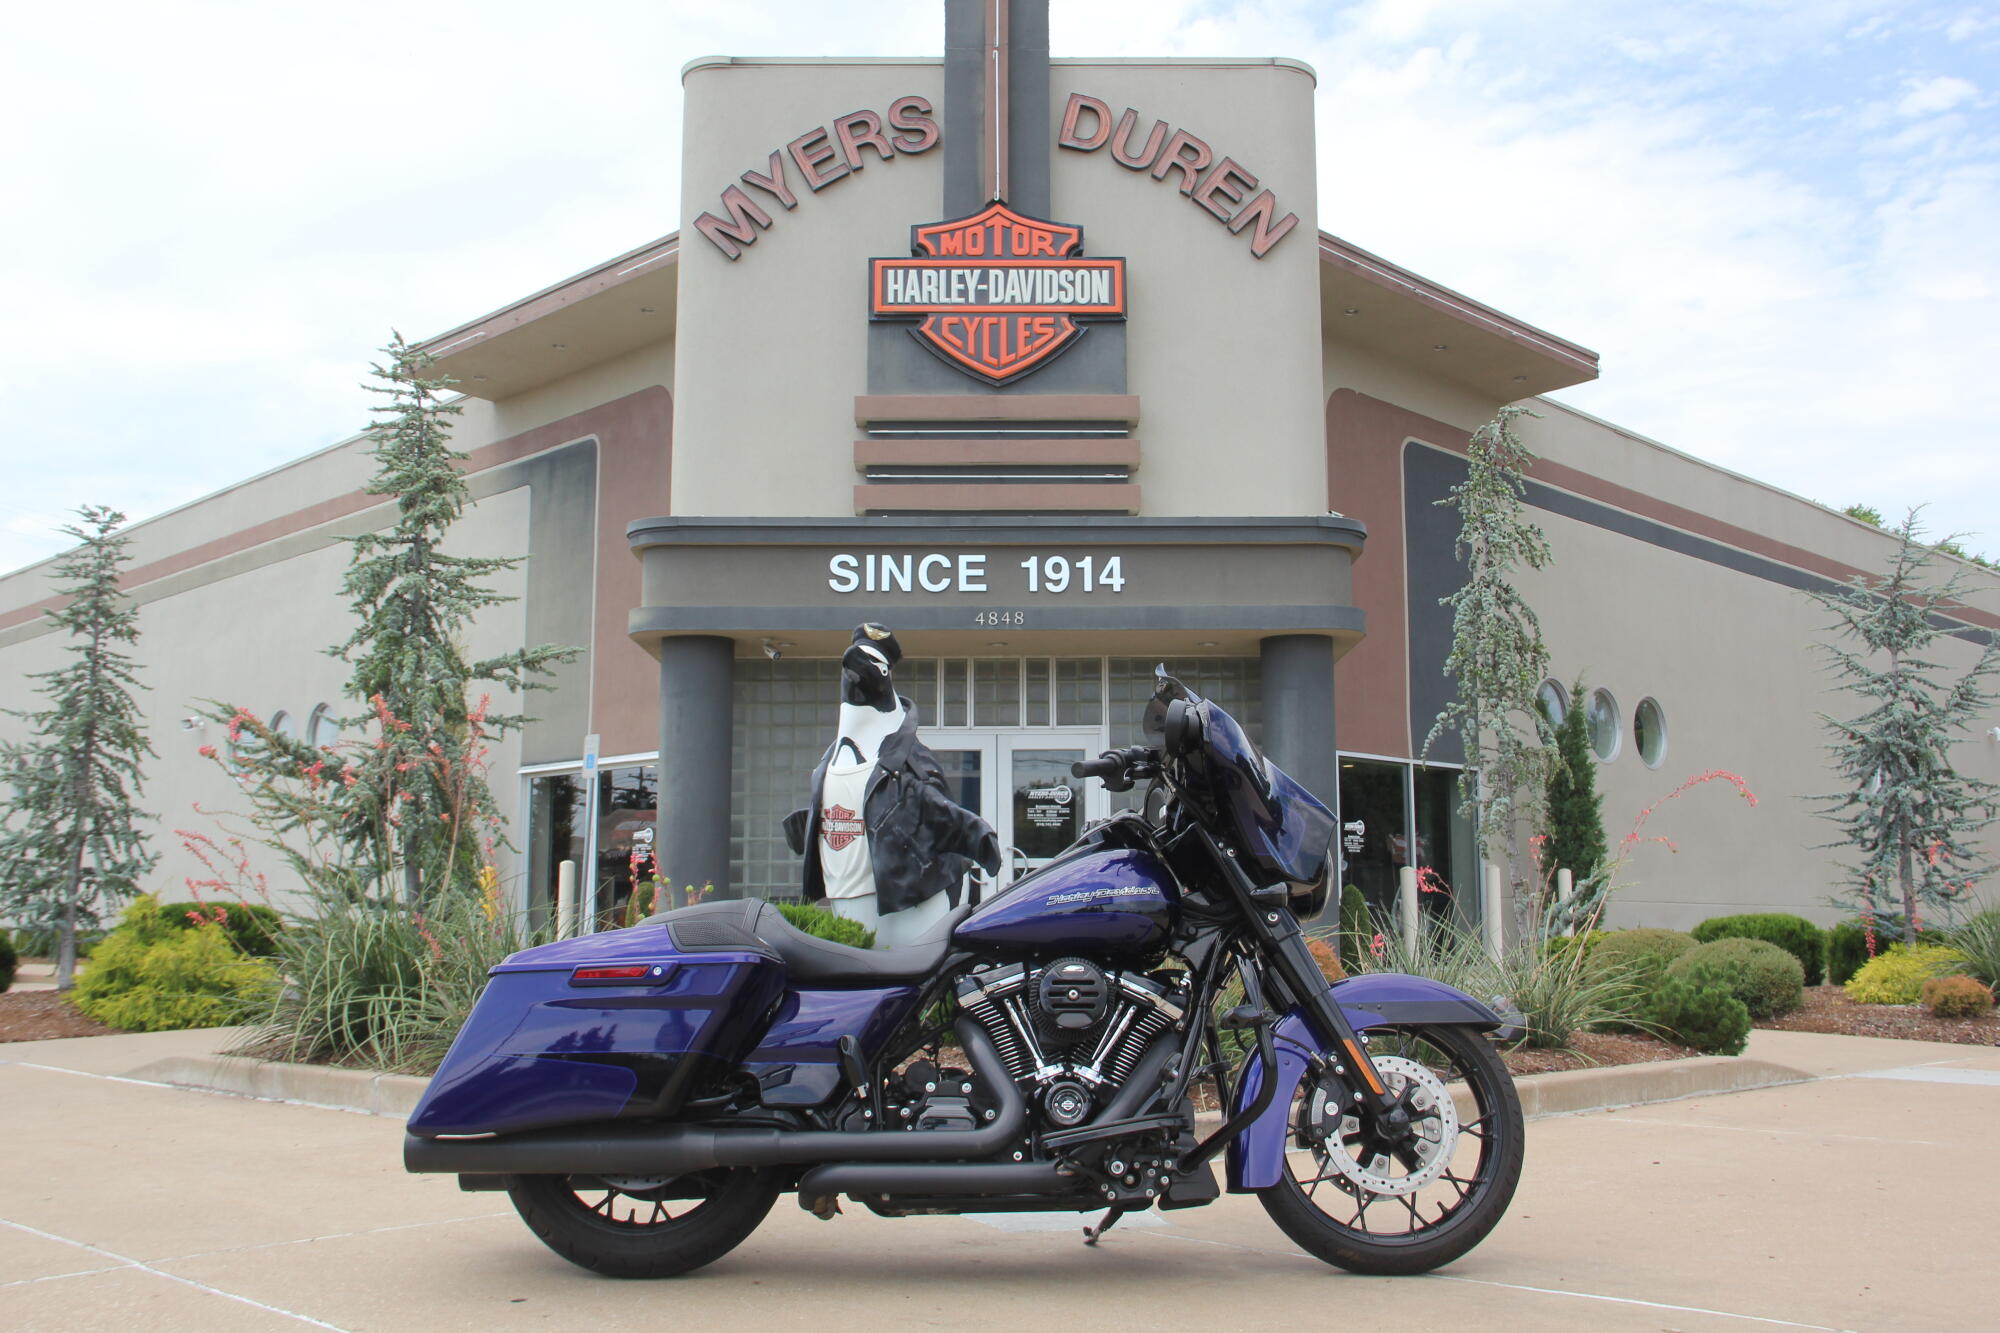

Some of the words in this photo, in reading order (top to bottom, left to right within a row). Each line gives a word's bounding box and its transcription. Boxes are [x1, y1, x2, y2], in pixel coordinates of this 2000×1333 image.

[692, 95, 941, 262] MYERS
[1058, 92, 1299, 260] DUREN
[939, 213, 1055, 257] MOTOR
[887, 268, 1111, 305] HARLEY-DAVIDSON
[941, 316, 1056, 368] CYCLES
[828, 553, 988, 593] SINCE
[1020, 555, 1126, 593] 1914
[975, 611, 1025, 626] 4848
